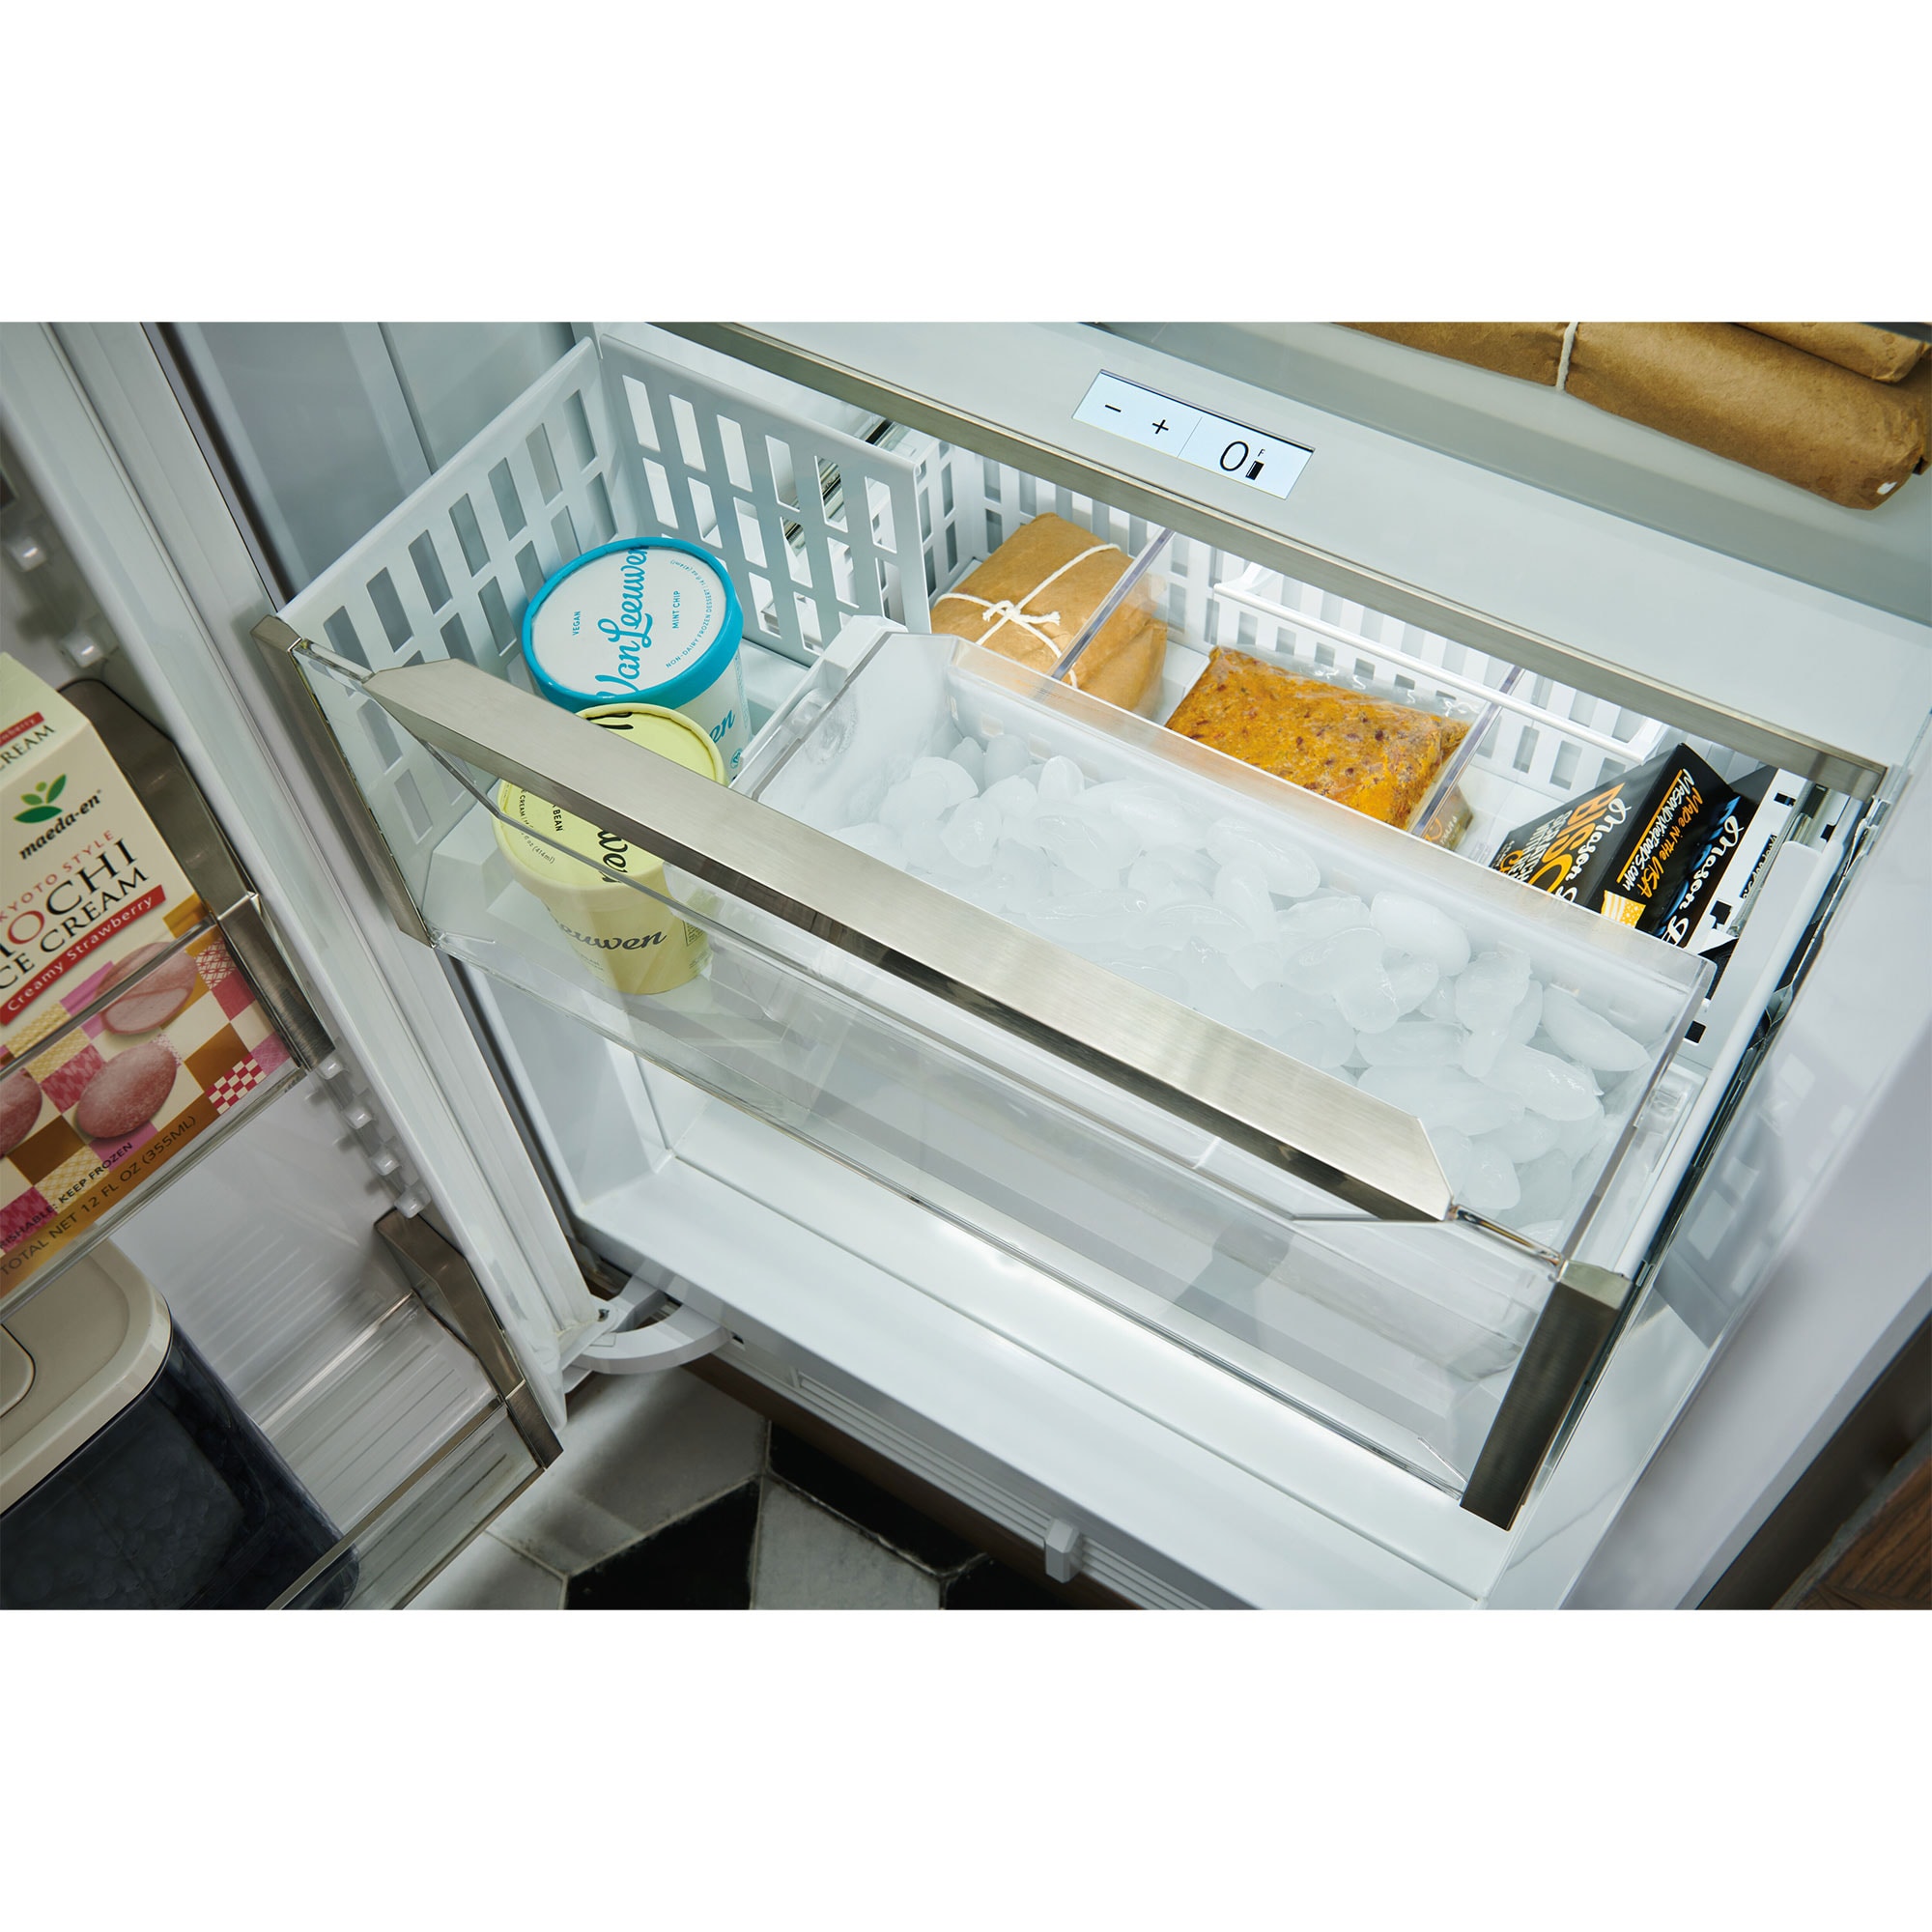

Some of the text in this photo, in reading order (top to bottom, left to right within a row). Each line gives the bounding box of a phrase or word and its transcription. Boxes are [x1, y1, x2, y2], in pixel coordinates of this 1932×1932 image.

[672, 590, 681, 608] CHIP
[703, 588, 713, 612] DESSERT
[572, 610, 582, 637] VEGAN
[696, 613, 713, 639] FROZEN
[665, 637, 699, 669] NON-DAIRY
[553, 809, 563, 832] BEAN
[1565, 798, 1632, 883] Mason
[63, 829, 114, 873] STYLE
[1679, 815, 1745, 910] Mason
[1636, 856, 1663, 898] USA
[0, 867, 149, 989] CE CREAM
[7, 895, 154, 1011] Creamy Strawberry
[0, 1141, 133, 1249] RISHABLE: KEEP FROZEN
[0, 1116, 196, 1275] TOTAL NET 12 FL OZ (355ML)
